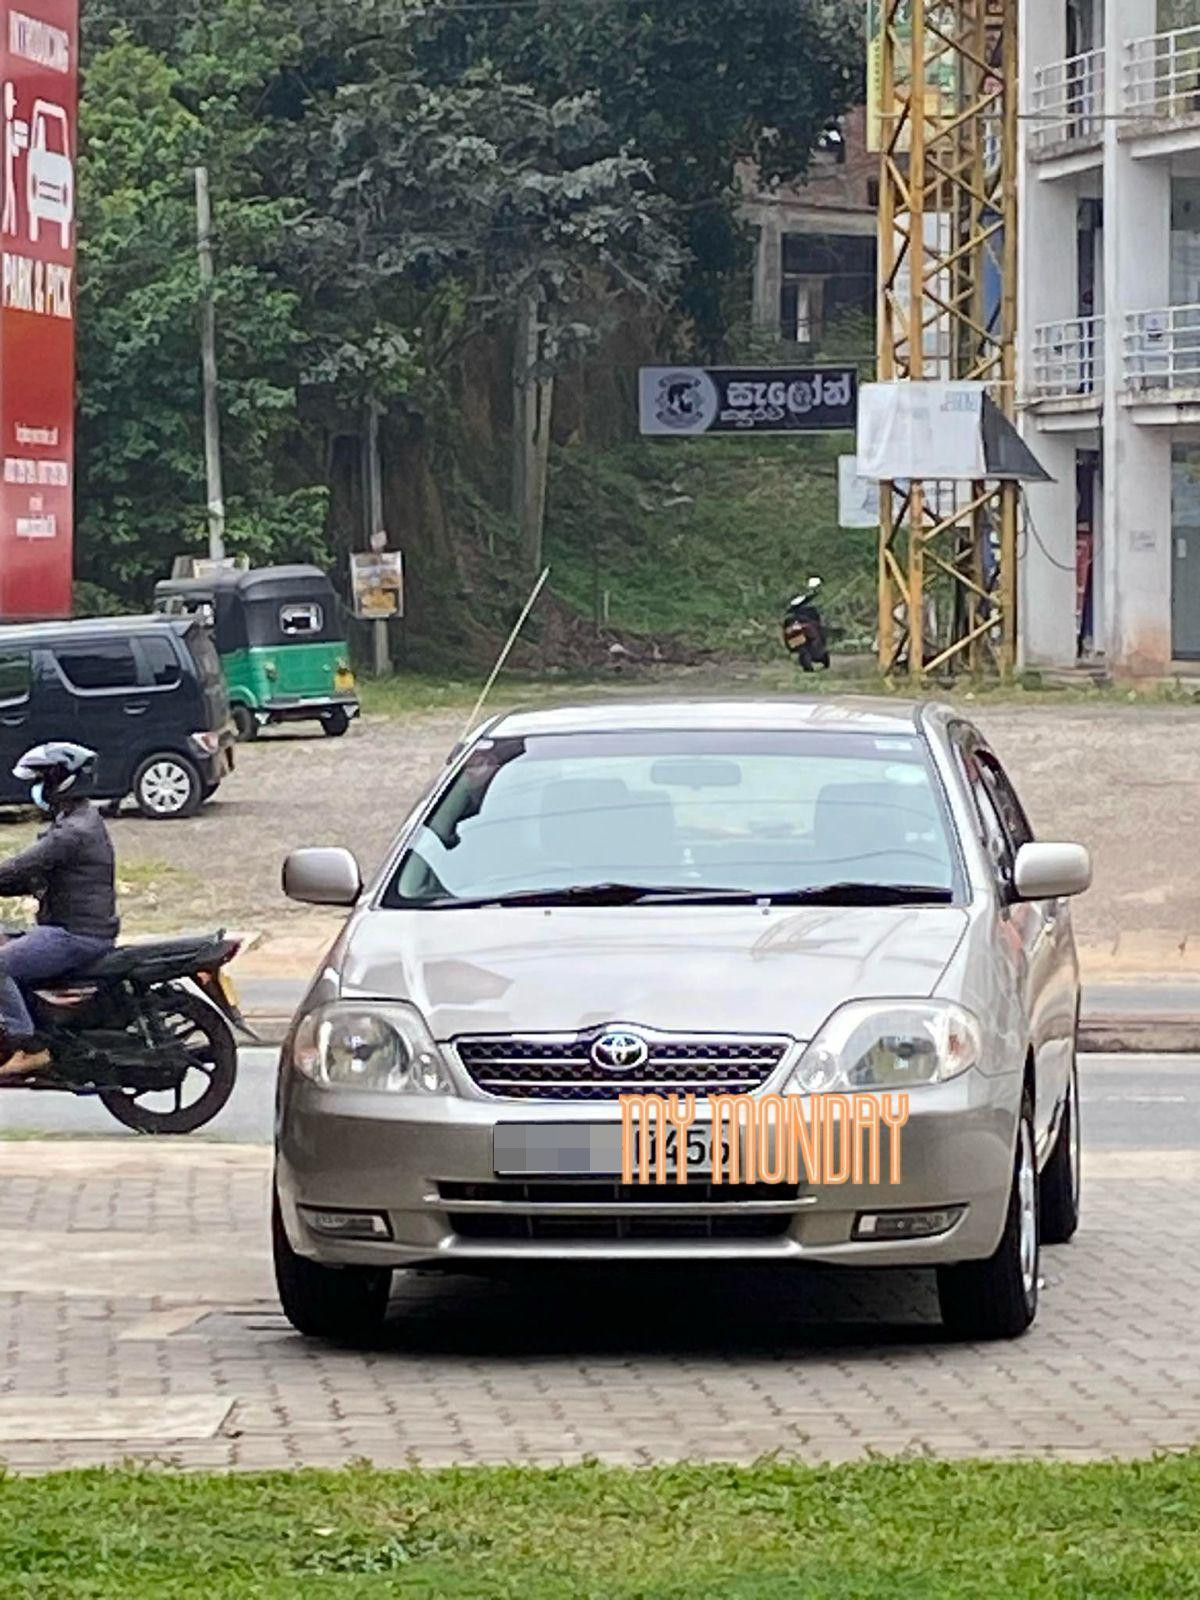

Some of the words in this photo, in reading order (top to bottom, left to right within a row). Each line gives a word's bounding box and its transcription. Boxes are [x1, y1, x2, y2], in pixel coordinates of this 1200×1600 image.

[2, 253, 33, 311] PARK
[35, 260, 44, 314] &
[46, 263, 72, 319] PICK
